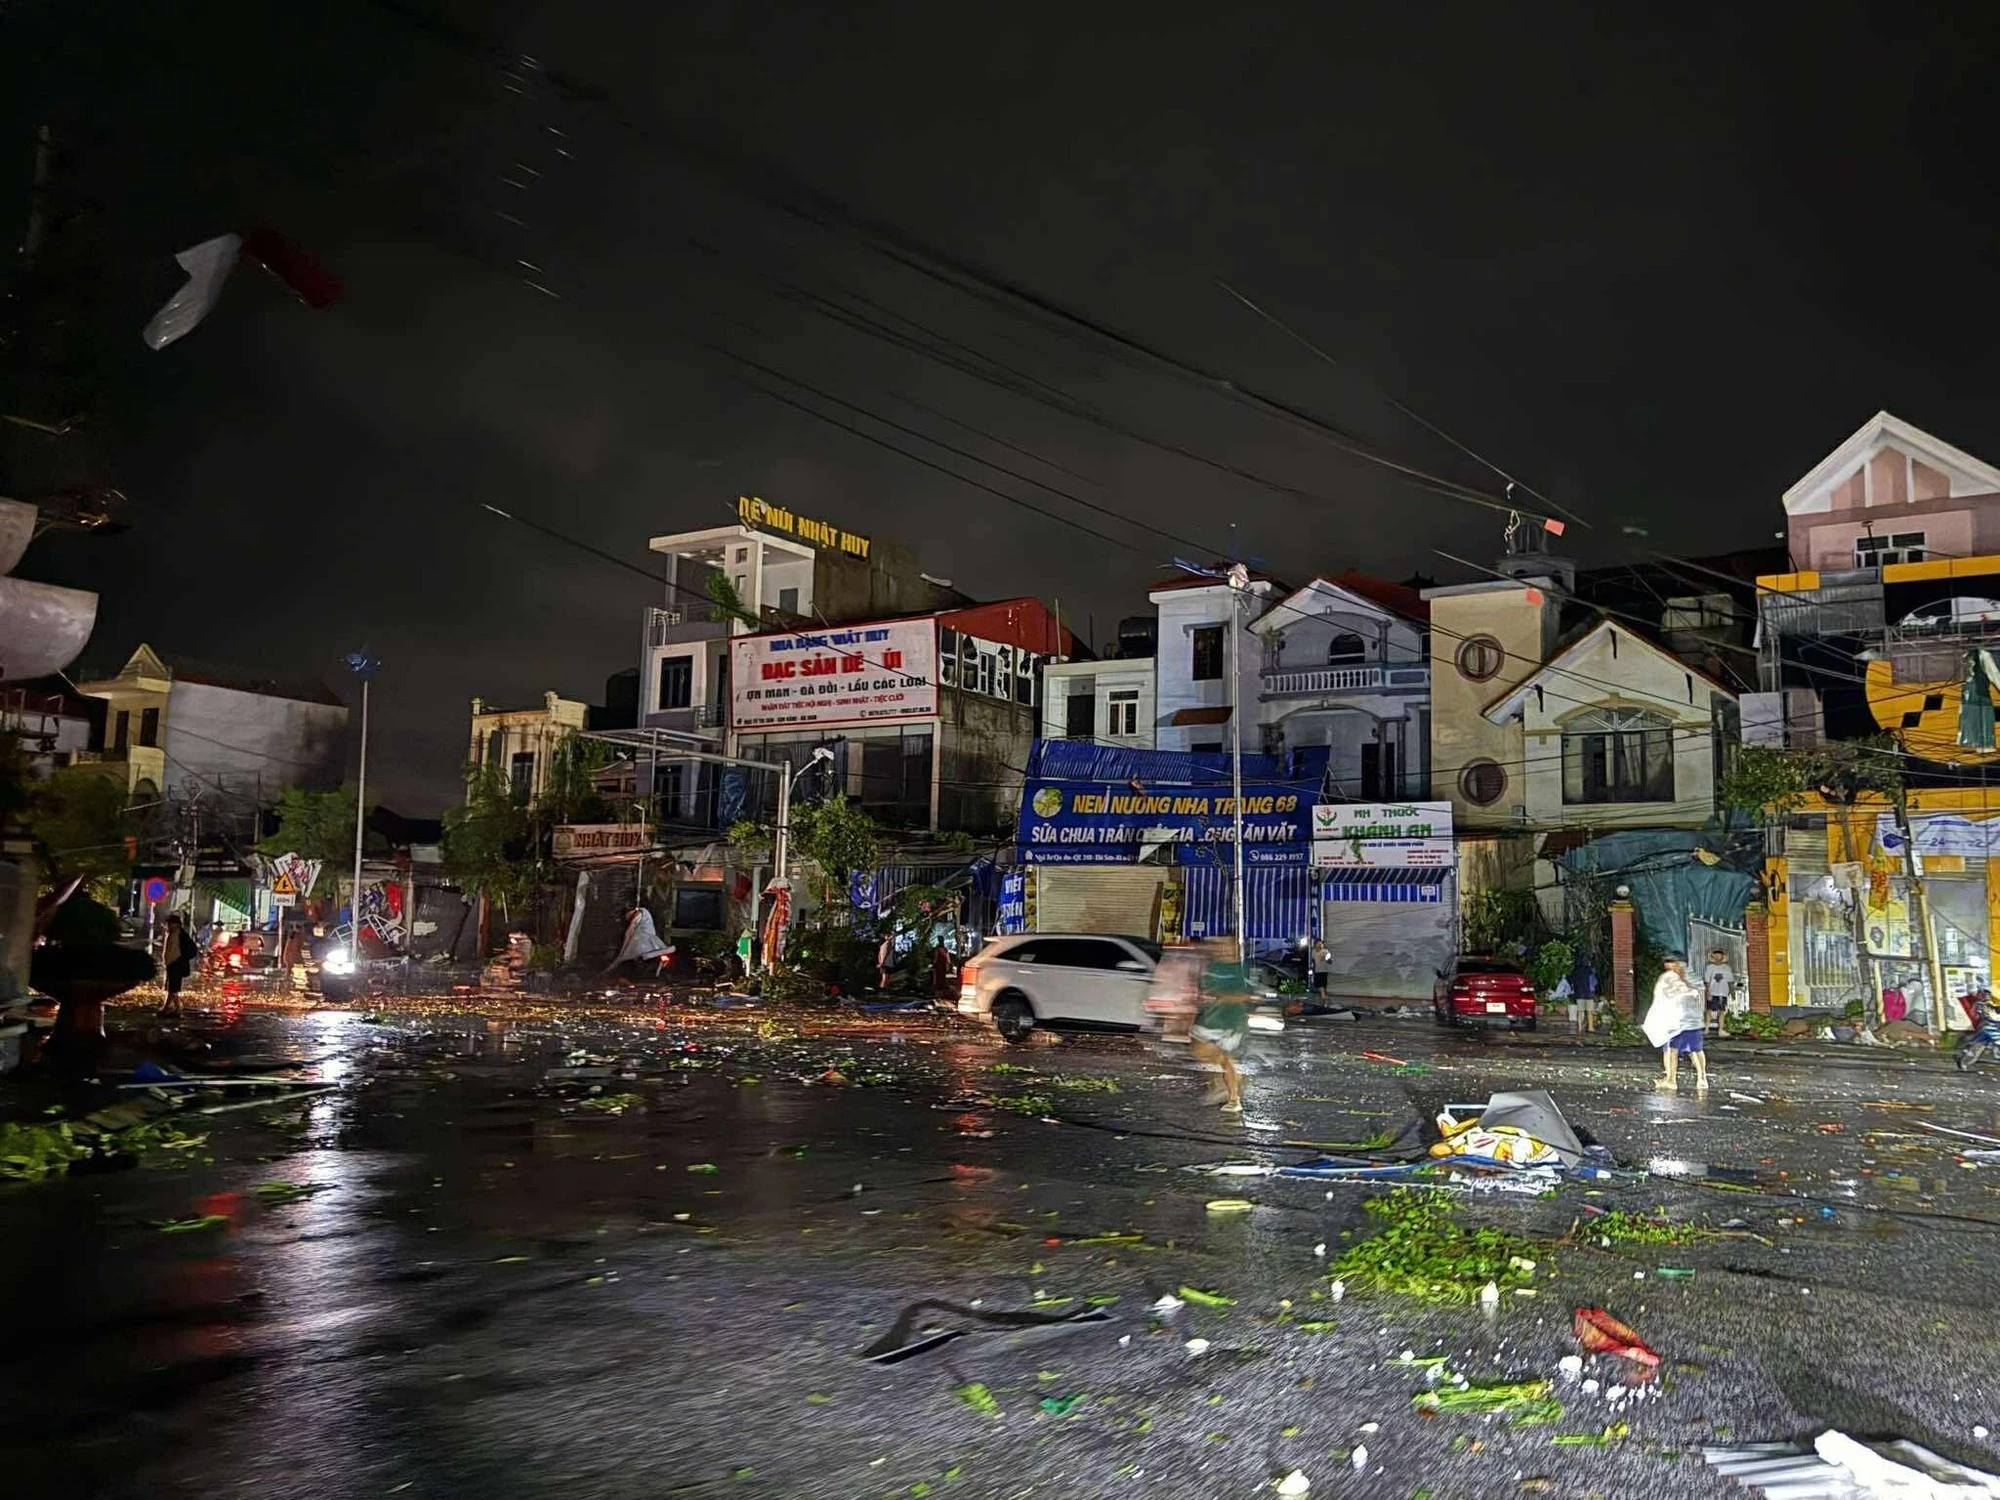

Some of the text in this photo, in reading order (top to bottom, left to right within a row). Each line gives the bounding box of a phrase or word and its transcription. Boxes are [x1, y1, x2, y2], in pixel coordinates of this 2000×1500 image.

[840, 532, 870, 558] HUY
[800, 652, 837, 677] SẢN
[1072, 795, 1107, 813] NEM
[1172, 797, 1209, 814] NHA
[1214, 797, 1274, 814] TRANG
[1275, 796, 1298, 812] 68
[1060, 827, 1095, 842] CHUA
[1198, 828, 1236, 842] ONG
[1243, 823, 1264, 842] ĂN
